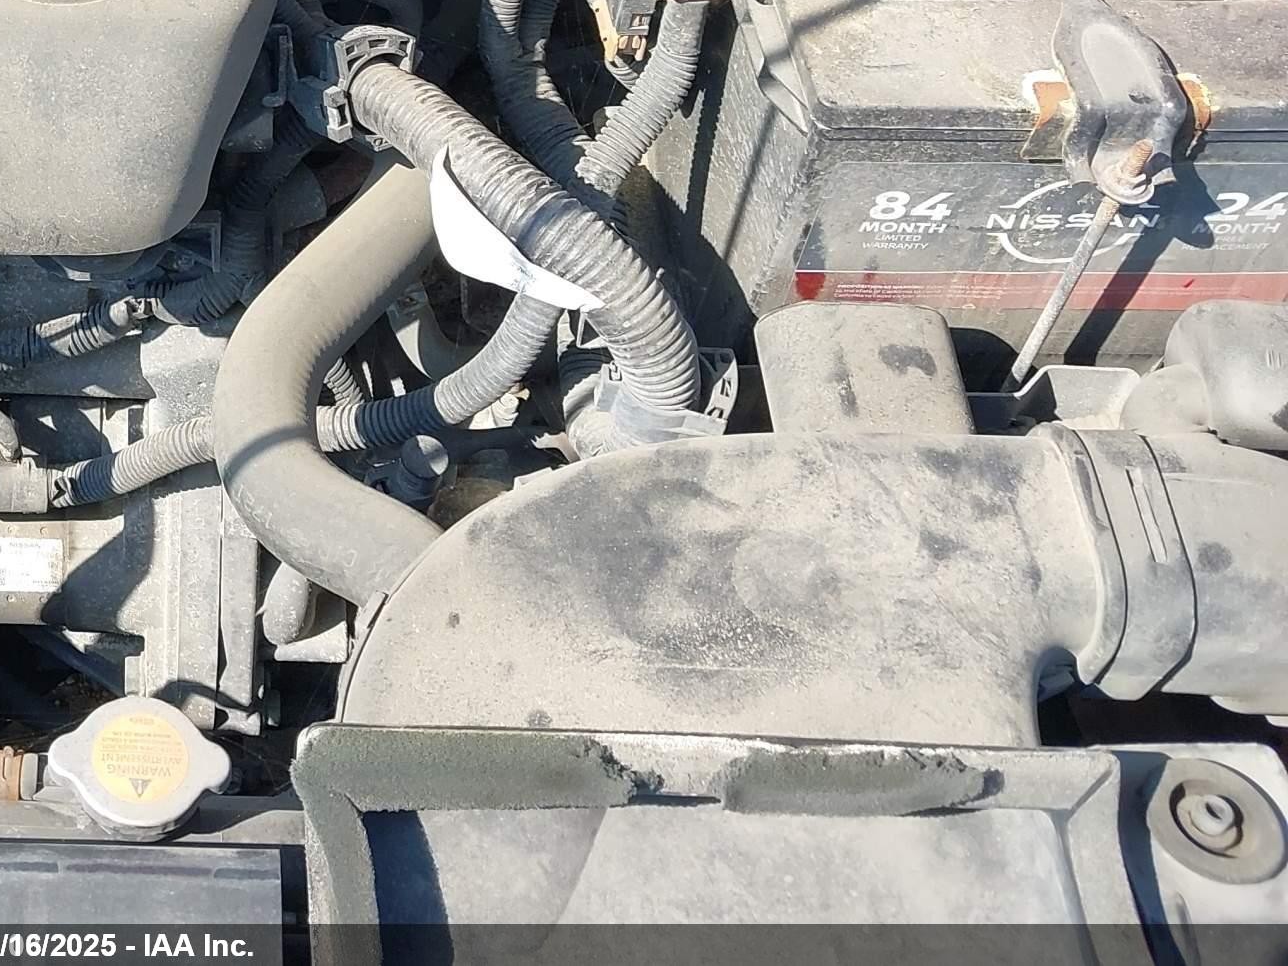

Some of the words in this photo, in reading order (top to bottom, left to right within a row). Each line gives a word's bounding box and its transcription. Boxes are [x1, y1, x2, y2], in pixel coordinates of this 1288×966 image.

[869, 191, 955, 221] 84
[1203, 191, 1288, 221] 24
[858, 222, 947, 233] MONTH
[1192, 222, 1281, 234] MONTH
[101, 753, 182, 765] AVERTISSEMENT
[106, 764, 171, 776] WARNING
